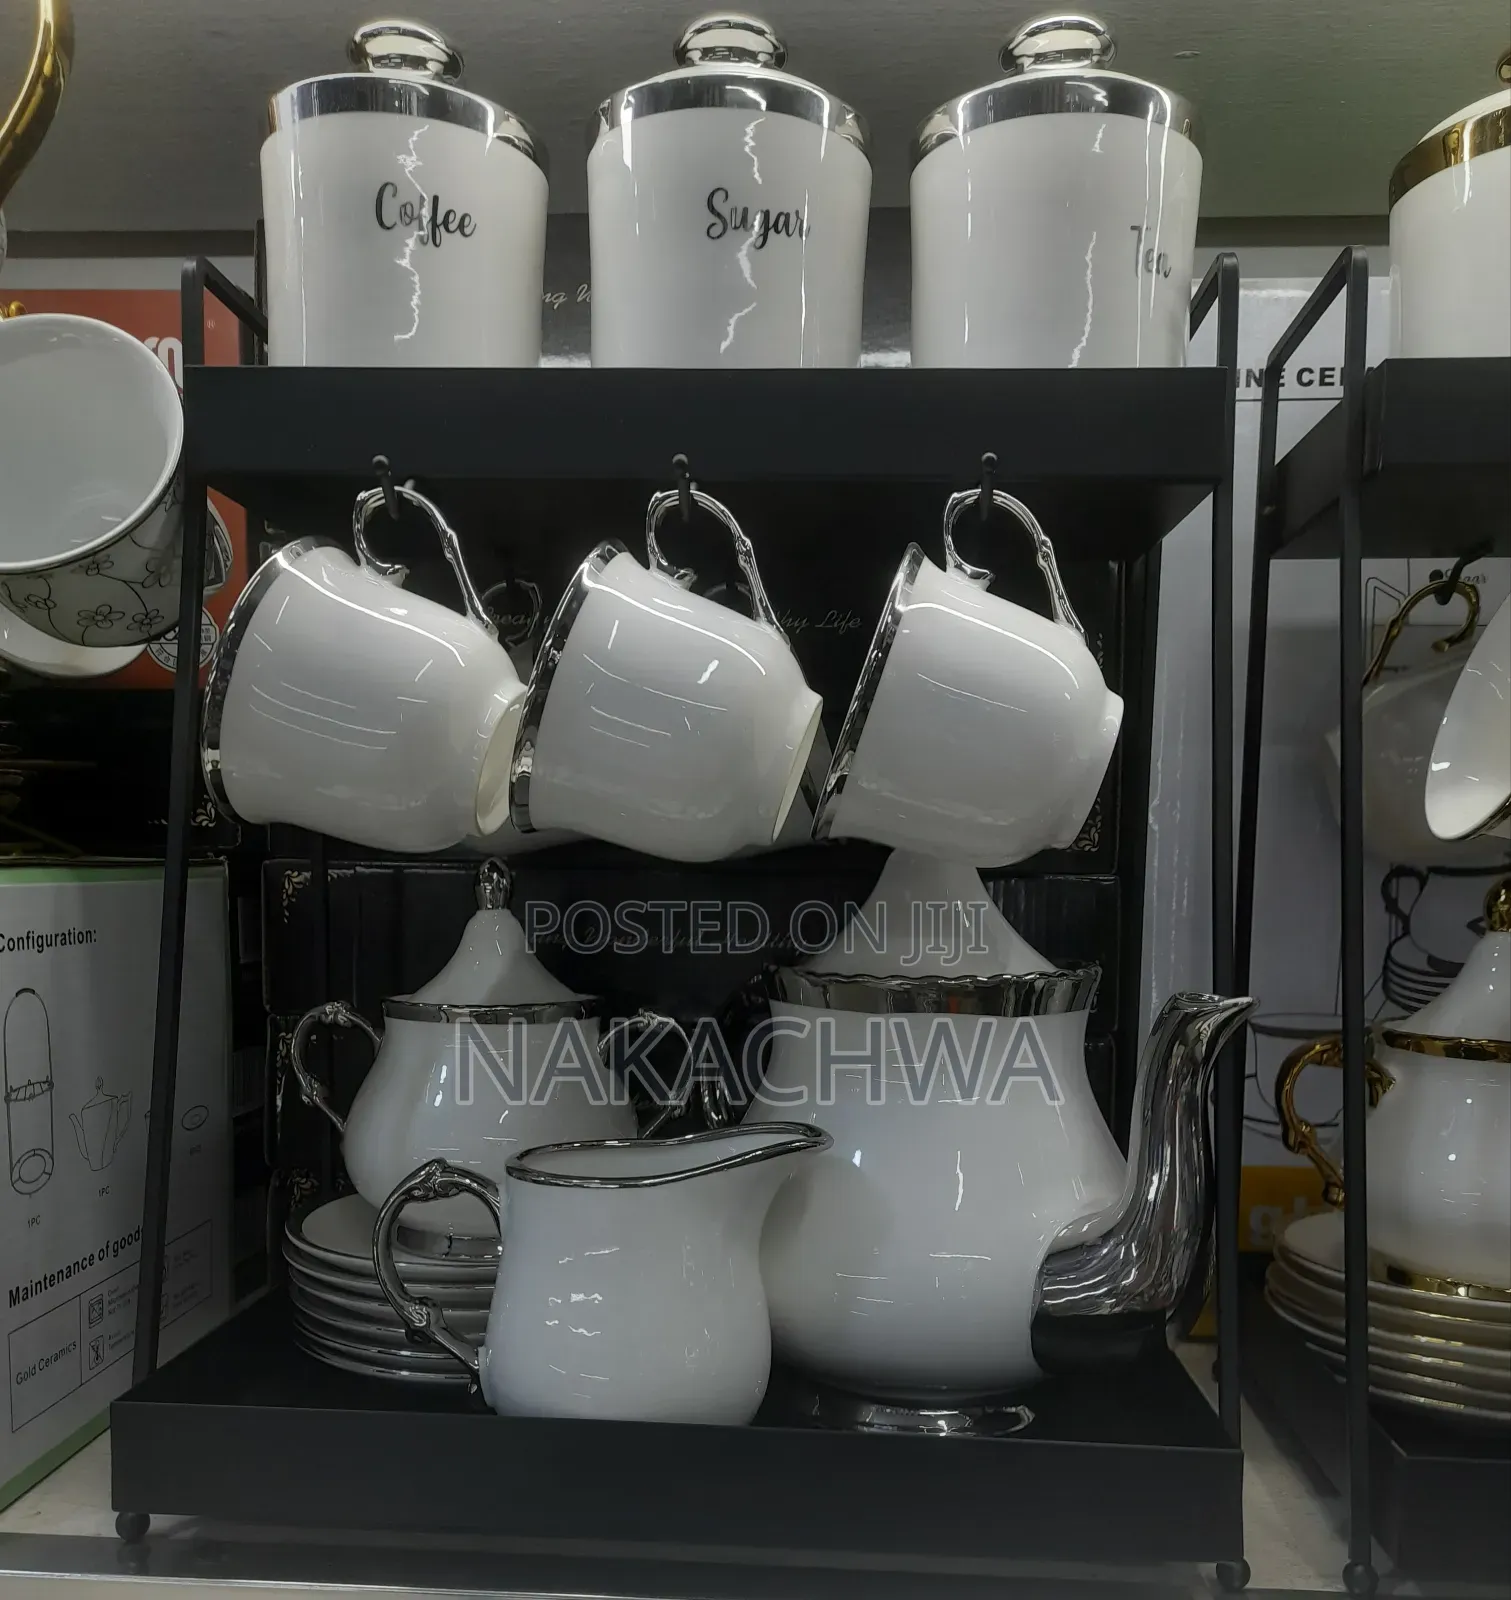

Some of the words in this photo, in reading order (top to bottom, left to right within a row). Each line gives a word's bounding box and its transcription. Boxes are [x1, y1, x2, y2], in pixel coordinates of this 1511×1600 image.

[375, 181, 477, 248] Coffee
[706, 186, 811, 250] Sugar
[1130, 225, 1172, 279] Tea
[814, 609, 863, 635] Life
[27, 1214, 41, 1228] 1PC
[8, 1253, 95, 1309] Maintenance
[98, 1240, 111, 1261] of
[113, 1225, 143, 1258] good
[15, 1363, 37, 1386] Gold
[38, 1340, 77, 1371] Ceramics
